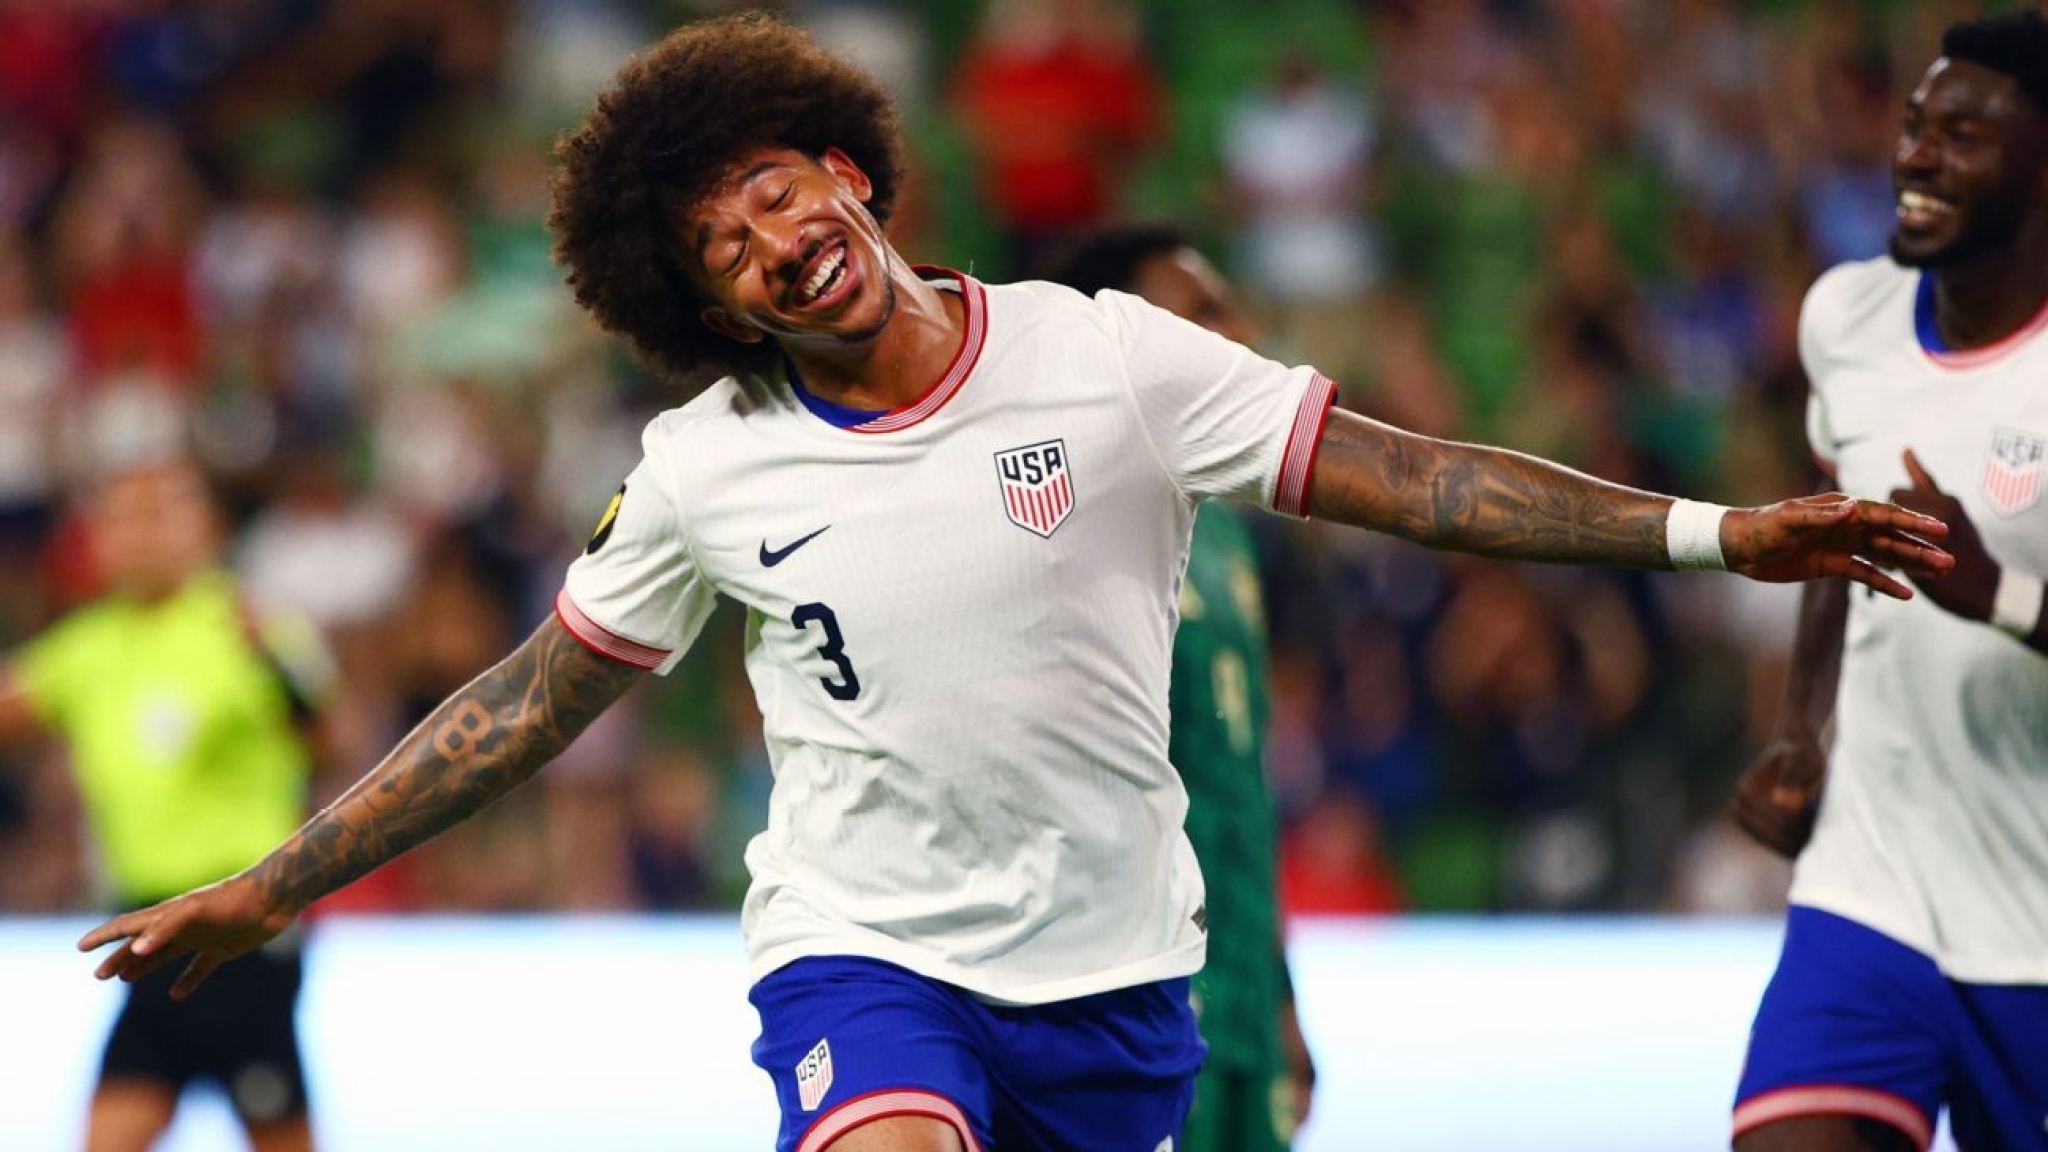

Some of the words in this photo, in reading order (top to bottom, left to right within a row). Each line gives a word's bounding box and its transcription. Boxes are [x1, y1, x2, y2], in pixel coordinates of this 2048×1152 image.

[1001, 446, 1062, 485] USA
[1995, 435, 2044, 468] USA
[790, 601, 860, 701] 3
[433, 699, 493, 762] 8
[798, 1044, 827, 1082] USA
